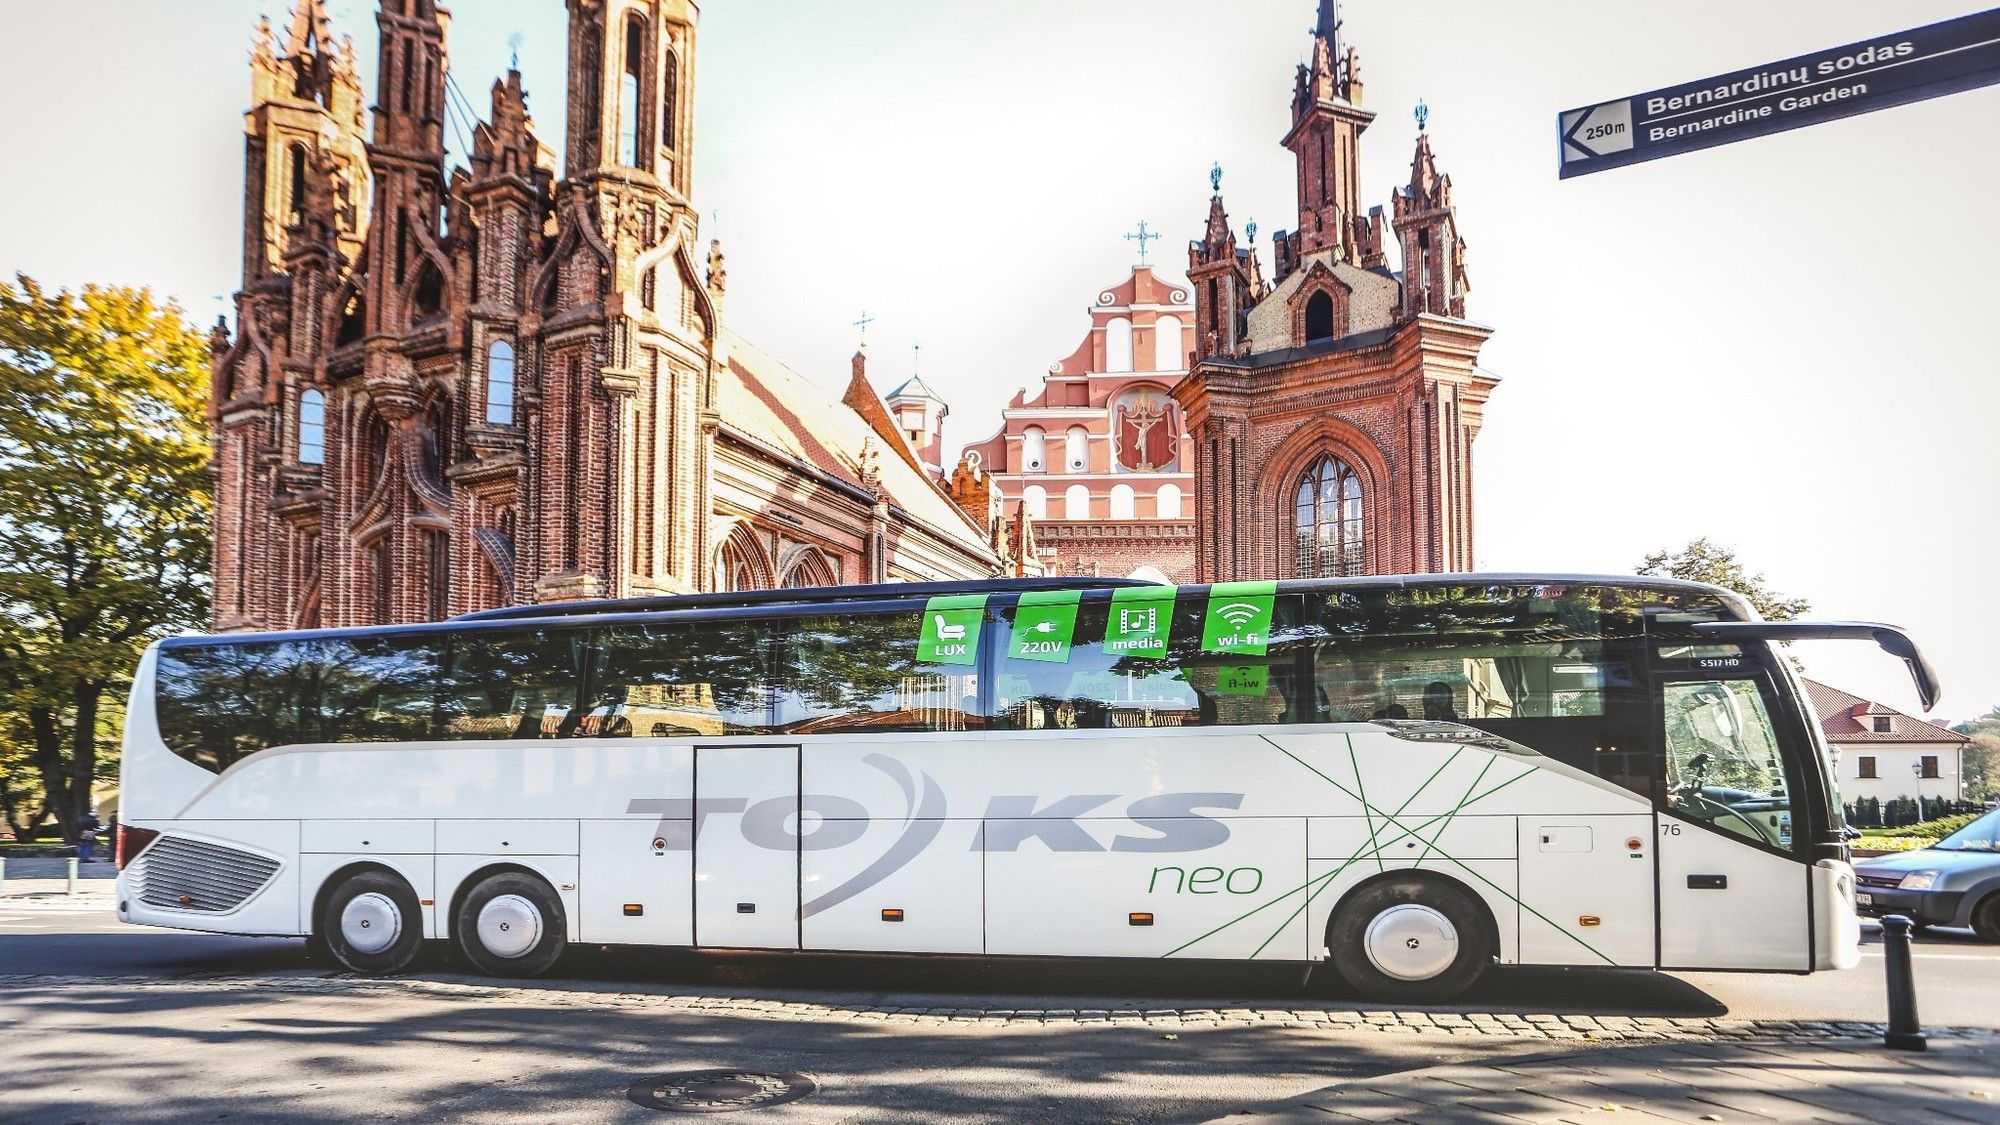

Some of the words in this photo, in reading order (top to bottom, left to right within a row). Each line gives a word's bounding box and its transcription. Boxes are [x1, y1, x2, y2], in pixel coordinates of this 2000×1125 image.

[1647, 66, 1810, 115] Bernardinų
[1817, 39, 1915, 75] sodas
[1649, 102, 1772, 142] Bernardine
[1778, 81, 1868, 112] Garden
[1585, 121, 1626, 141] 250m
[1112, 637, 1164, 649] media
[1217, 633, 1259, 647] wi-fi
[935, 644, 967, 656] LUX
[1020, 641, 1063, 654] 220V
[1724, 658, 1739, 667] HD
[1660, 823, 1681, 836] 76
[1148, 865, 1264, 895] neo
